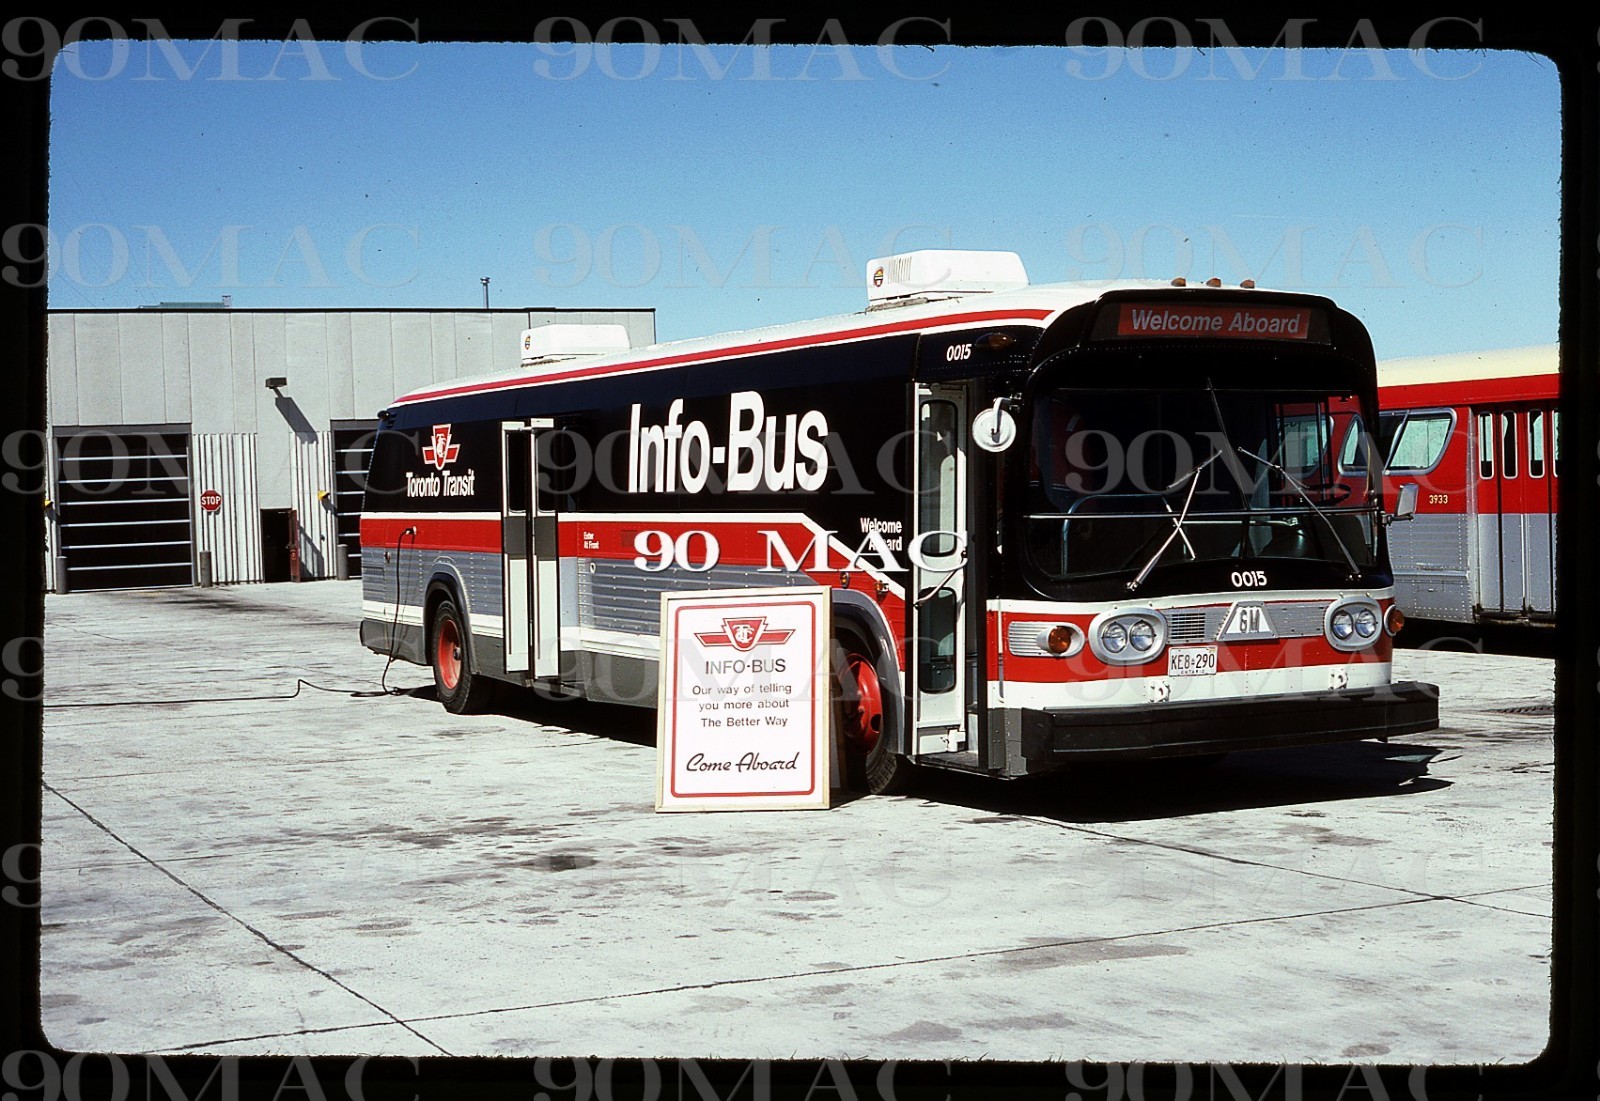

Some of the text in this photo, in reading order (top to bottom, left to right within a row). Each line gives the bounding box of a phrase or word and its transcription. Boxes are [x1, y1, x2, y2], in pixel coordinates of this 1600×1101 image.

[1132, 309, 1300, 334] Welcome Aboard
[946, 343, 972, 361] 0015
[628, 391, 829, 494] Info-Bus
[406, 469, 475, 497] Toronto Transit
[201, 495, 221, 505] STOP
[1429, 494, 1448, 504] 3933
[860, 517, 902, 533] Welcome
[868, 536, 902, 551] Aard
[1231, 570, 1267, 587] 0015
[1239, 608, 1260, 634] GM
[692, 684, 791, 695] Our way of telling
[699, 699, 789, 712] you more about
[701, 716, 788, 727] The Better Way
[686, 752, 800, 772] Come Aboard
